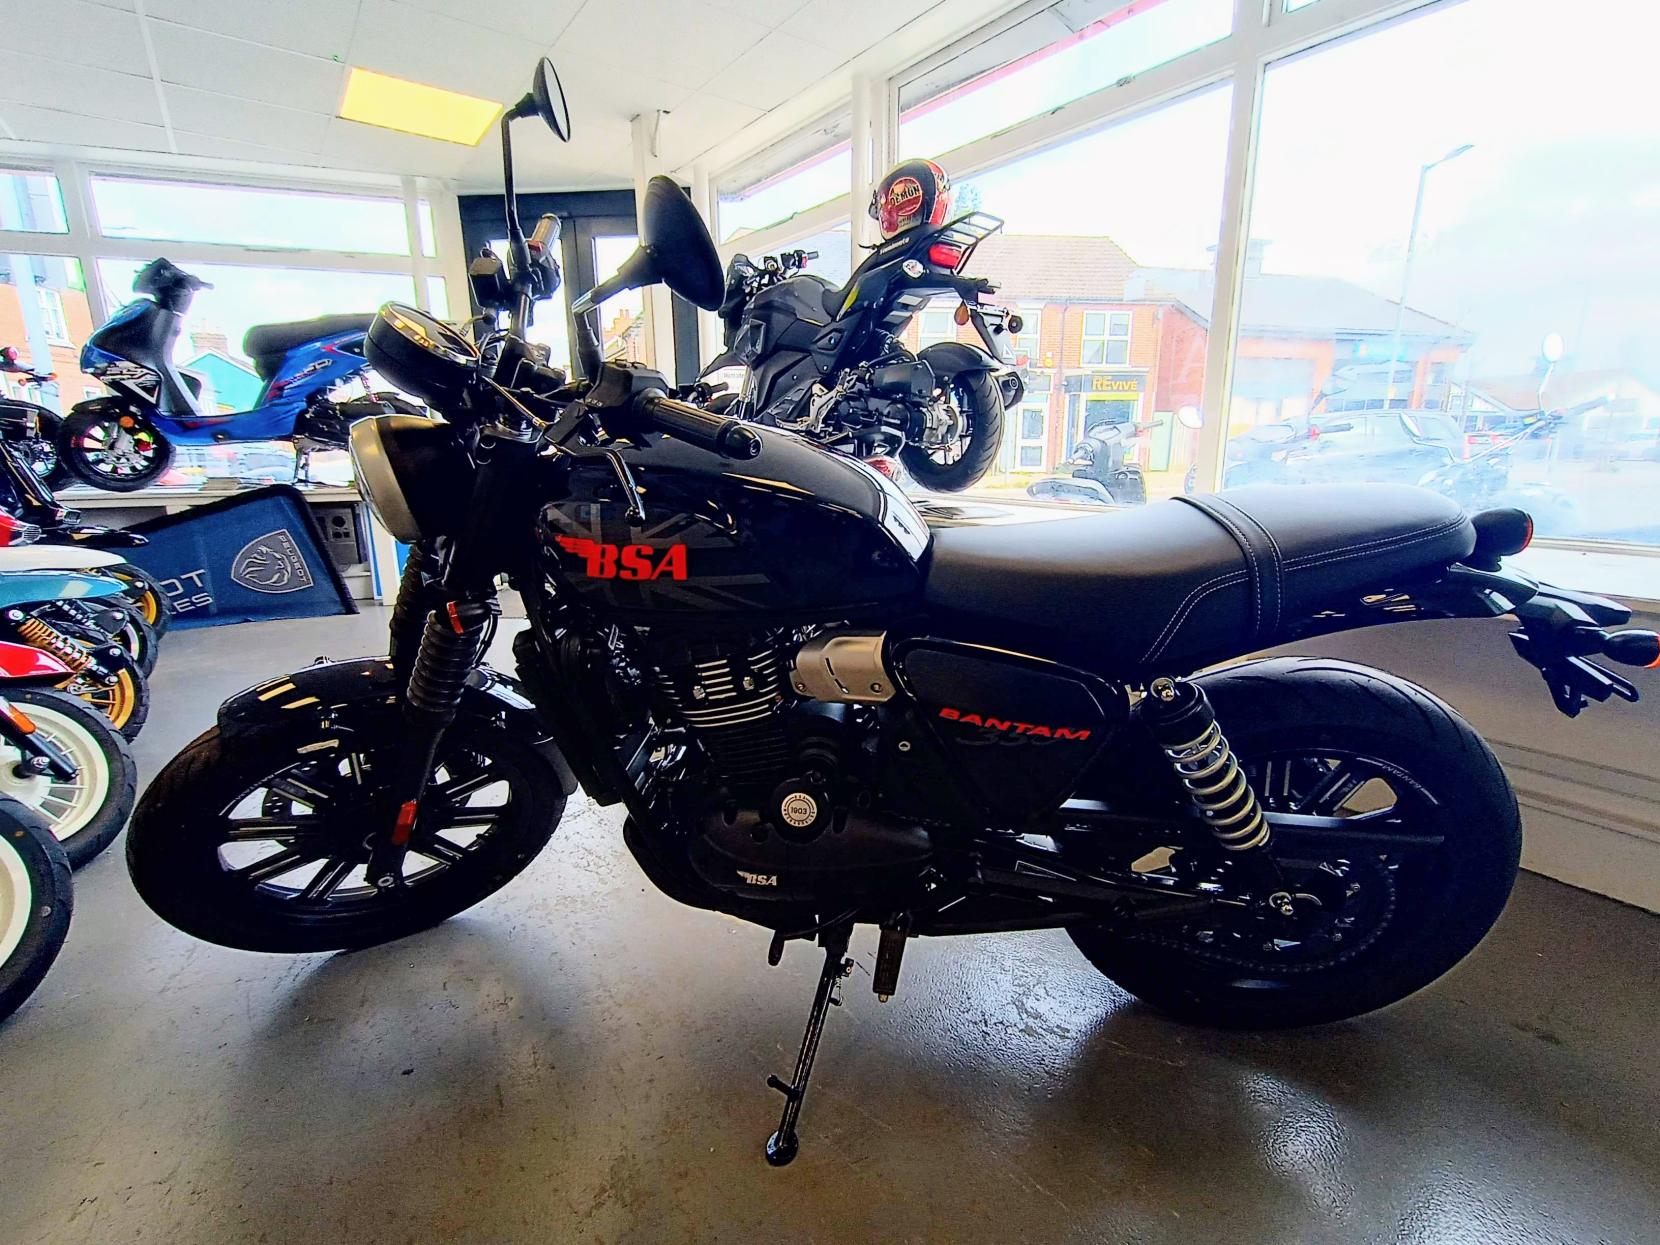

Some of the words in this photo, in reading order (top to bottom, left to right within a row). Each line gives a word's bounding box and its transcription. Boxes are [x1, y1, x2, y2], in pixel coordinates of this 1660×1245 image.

[279, 535, 308, 582] PEUGEOT
[587, 544, 688, 581] BSA
[939, 708, 1091, 740] BANTAM
